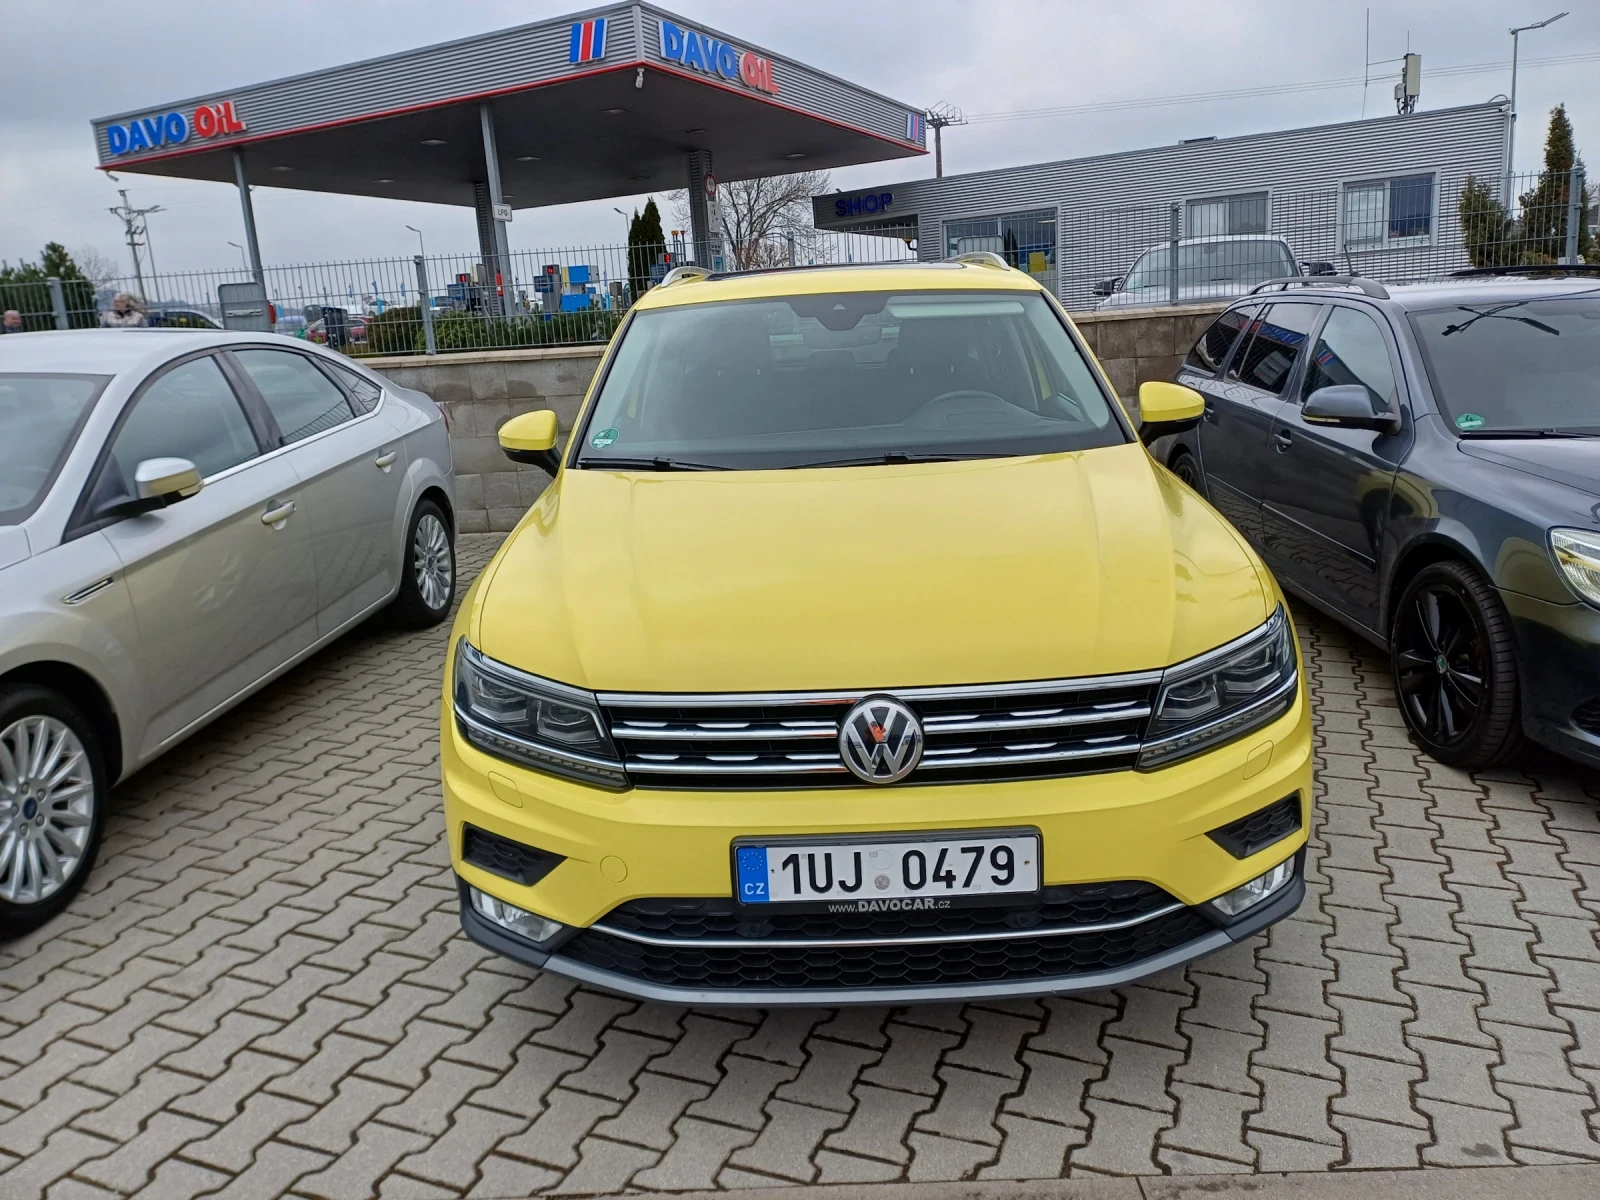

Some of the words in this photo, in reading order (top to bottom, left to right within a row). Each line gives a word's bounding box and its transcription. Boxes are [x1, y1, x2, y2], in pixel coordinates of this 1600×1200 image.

[659, 21, 737, 79] DAVO
[107, 111, 190, 155] DAVO
[497, 208, 508, 217] LPG
[835, 192, 894, 217] SHOP
[782, 851, 863, 895] 1UJ
[902, 845, 1015, 891] 0479
[744, 882, 765, 896] CZ
